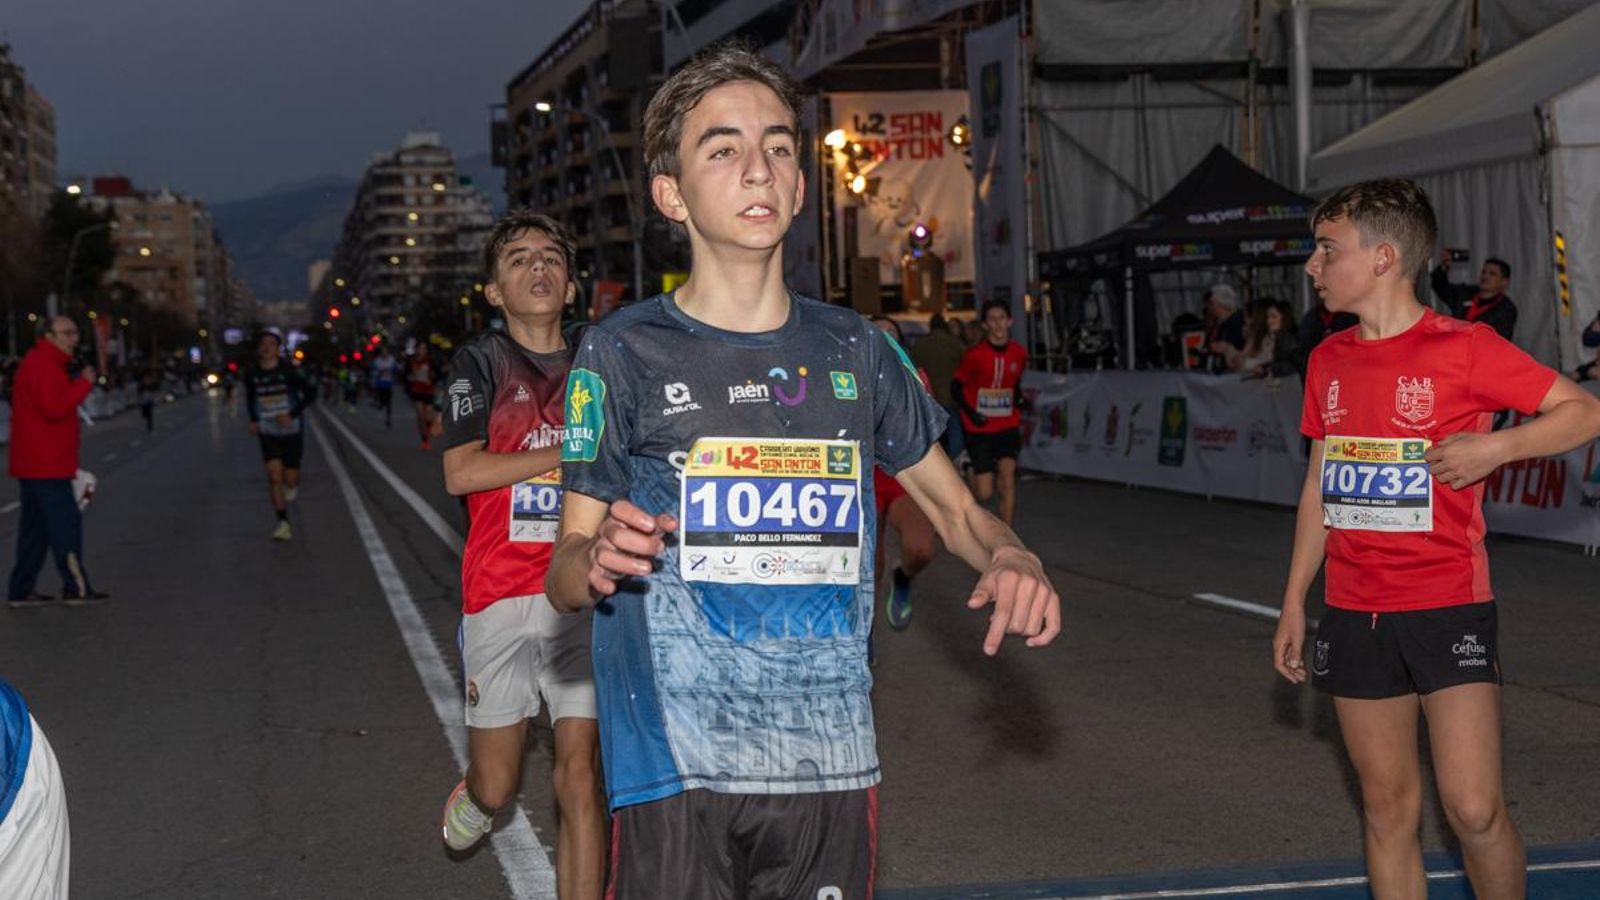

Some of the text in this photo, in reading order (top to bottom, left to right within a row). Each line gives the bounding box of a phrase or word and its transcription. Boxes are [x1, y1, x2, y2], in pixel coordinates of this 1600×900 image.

[853, 111, 943, 136] 42 SAN
[727, 446, 759, 470] 42
[760, 459, 782, 469] SAN
[784, 459, 821, 470] ANTON
[1325, 463, 1428, 496] 10732
[514, 485, 562, 511] 10
[691, 481, 856, 527] 10467
[734, 534, 757, 542] PACO
[758, 534, 780, 542] BELLO
